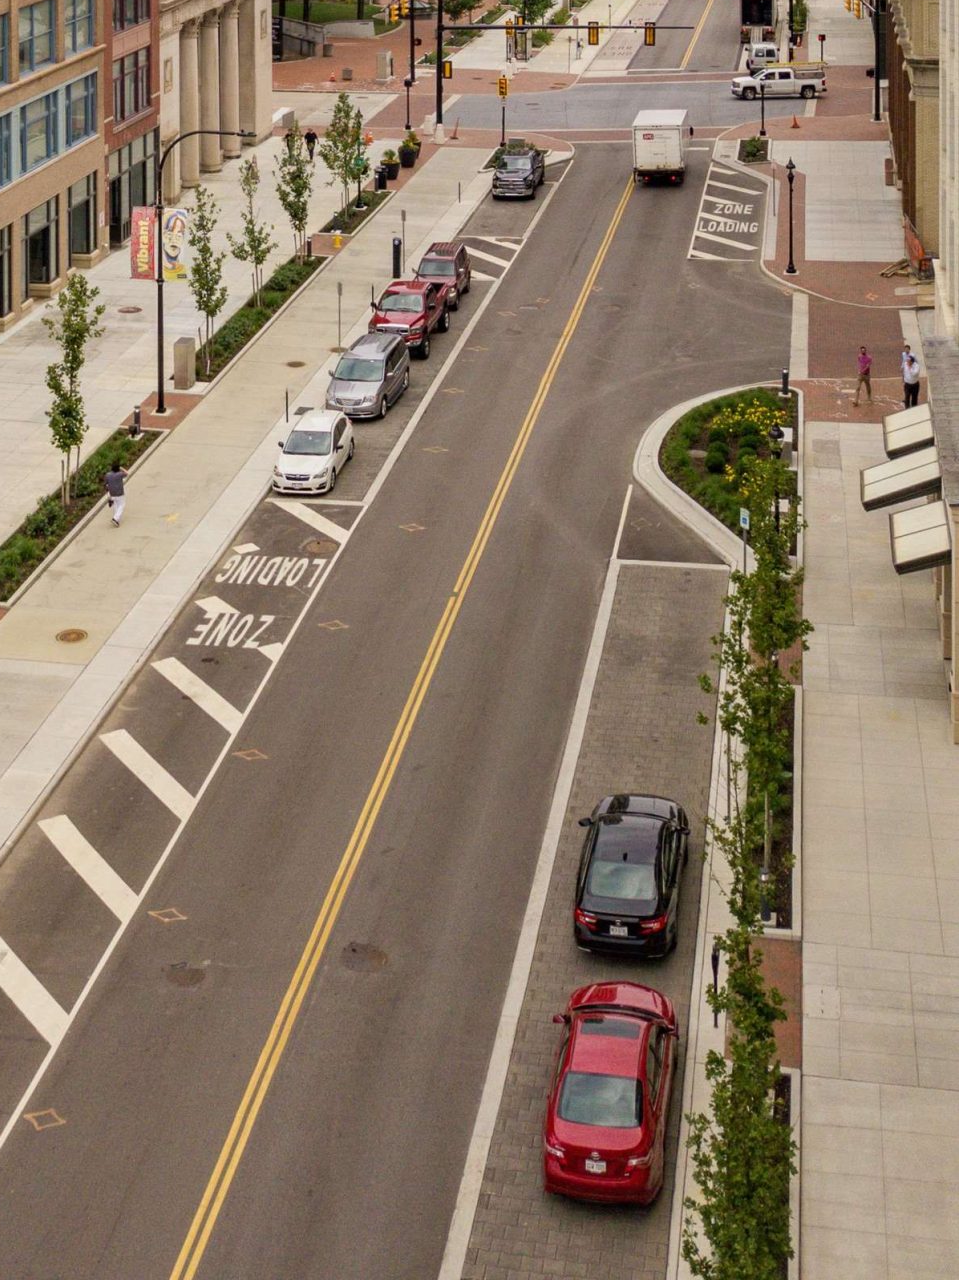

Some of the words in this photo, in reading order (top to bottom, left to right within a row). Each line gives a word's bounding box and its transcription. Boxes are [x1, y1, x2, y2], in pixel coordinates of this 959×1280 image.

[713, 203, 754, 214] ZONE
[699, 221, 759, 233] LOADING
[215, 555, 328, 588] LOADING
[185, 612, 276, 648] ZONE
